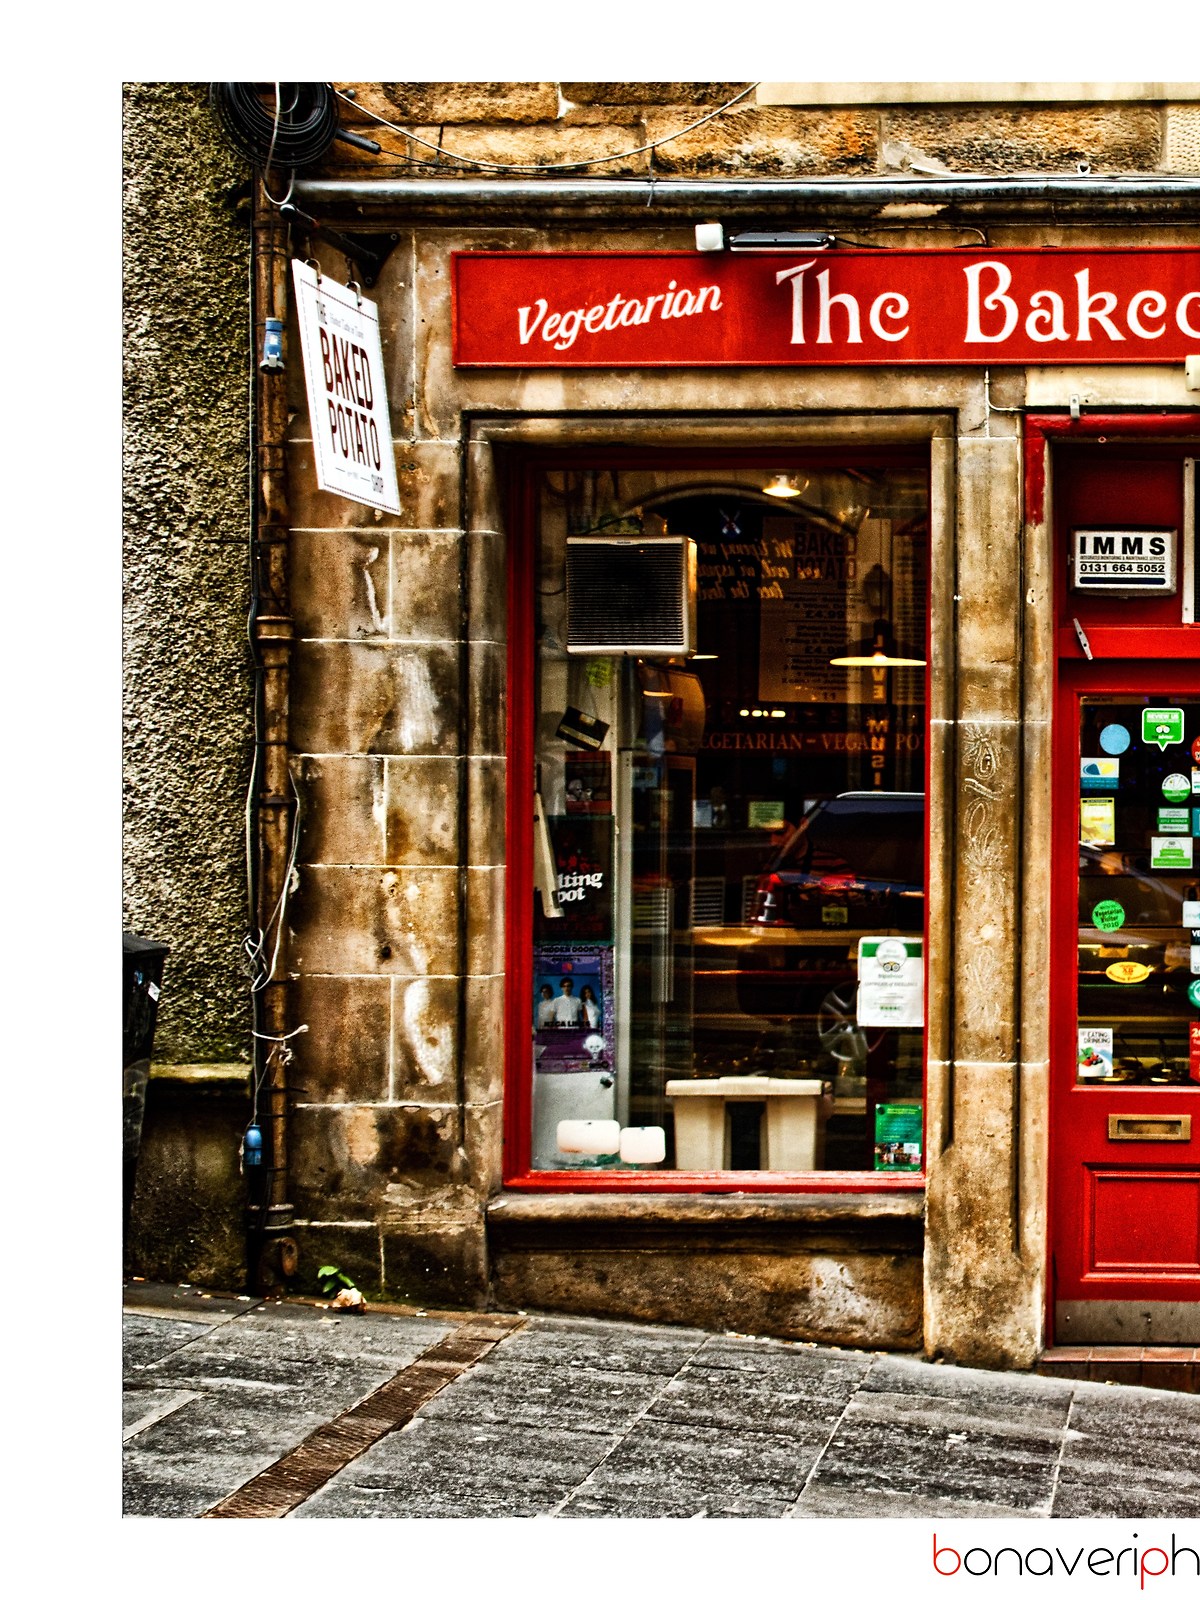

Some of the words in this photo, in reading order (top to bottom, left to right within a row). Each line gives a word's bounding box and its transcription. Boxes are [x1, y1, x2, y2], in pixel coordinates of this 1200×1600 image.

[517, 281, 723, 350] Vegetarian
[776, 259, 909, 345] The
[319, 327, 374, 411] BAKED
[327, 398, 382, 472] POTATO
[1080, 563, 1108, 572] 0131
[1112, 564, 1133, 572] 664
[1137, 564, 1165, 573] 5052
[702, 732, 803, 751] EGETARIAN
[557, 872, 604, 890] lting
